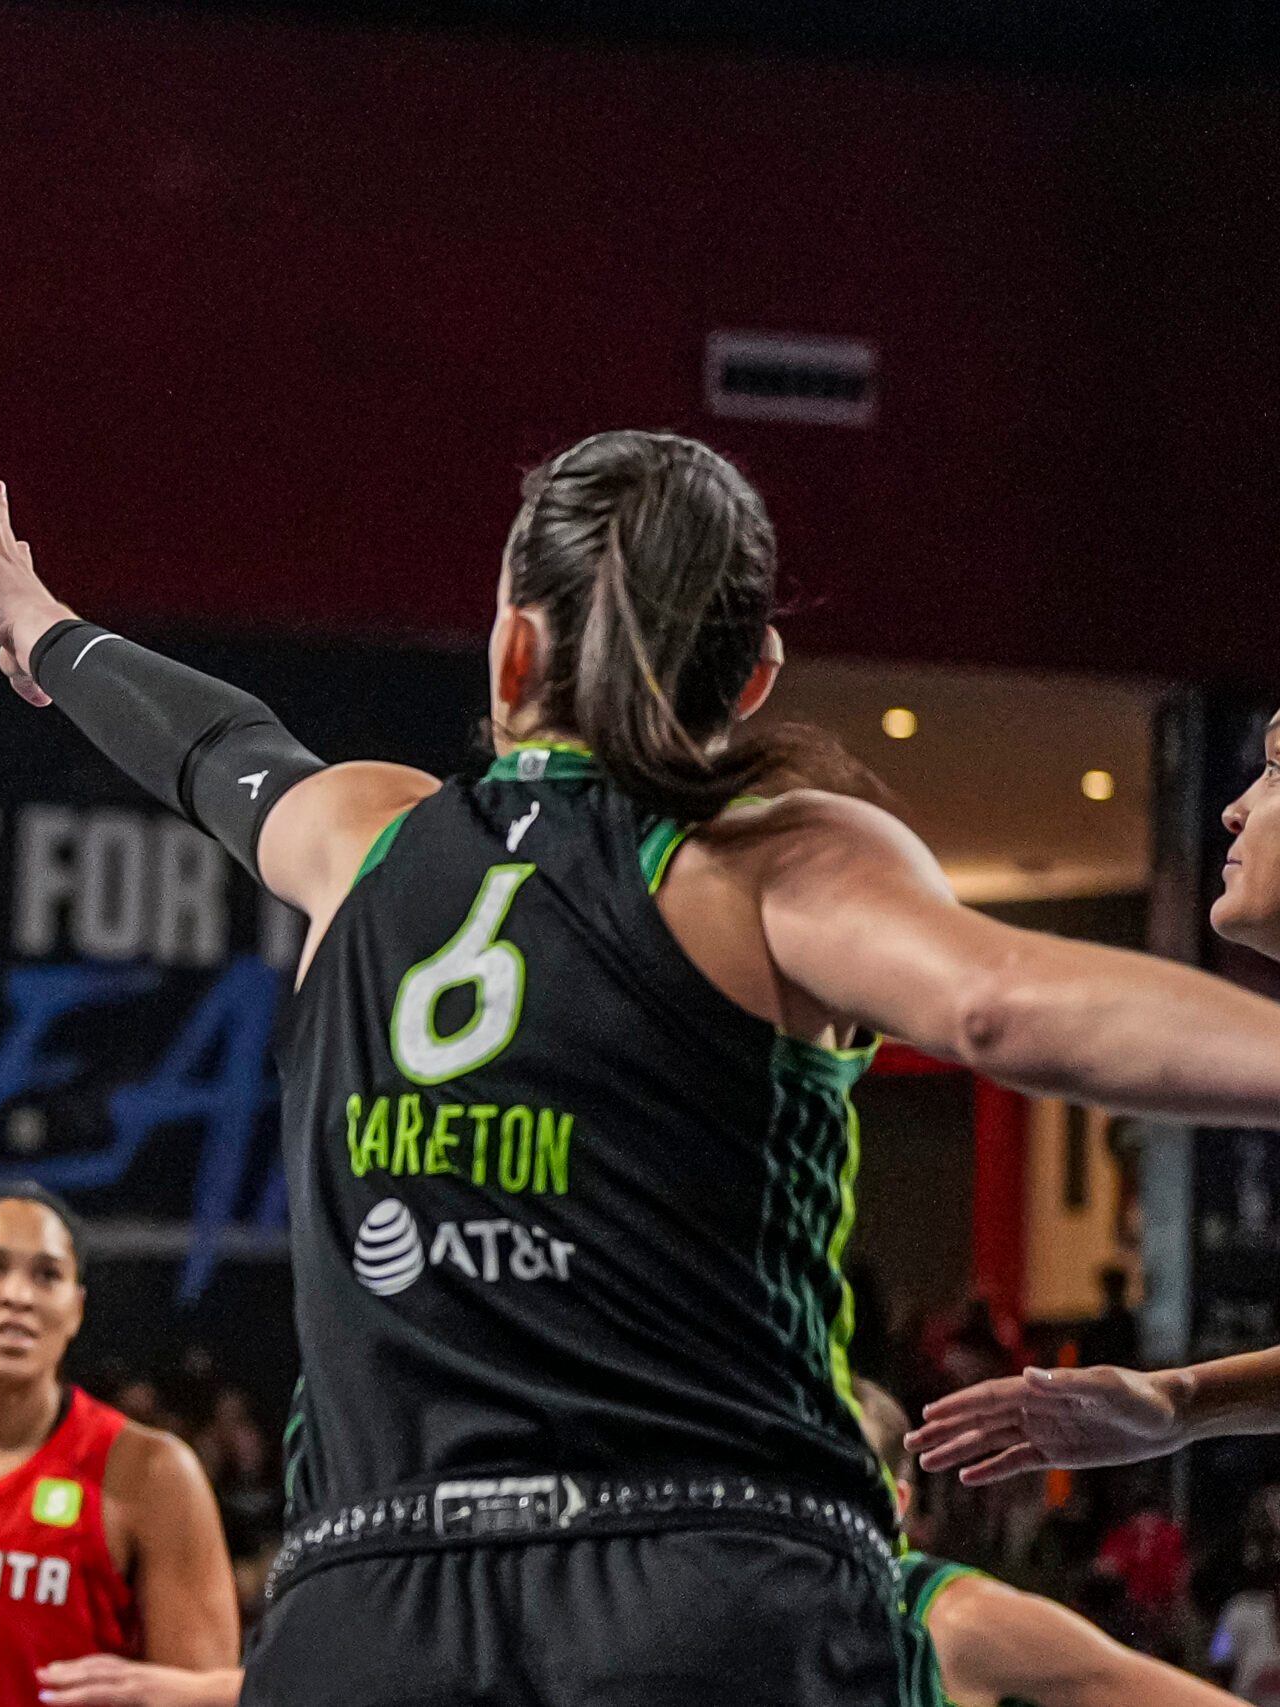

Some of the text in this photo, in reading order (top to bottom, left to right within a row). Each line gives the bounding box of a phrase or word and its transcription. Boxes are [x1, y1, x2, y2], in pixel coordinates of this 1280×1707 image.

[18, 807, 224, 966] FOR
[391, 863, 536, 1086] 6
[429, 1217, 576, 1282] AT&T
